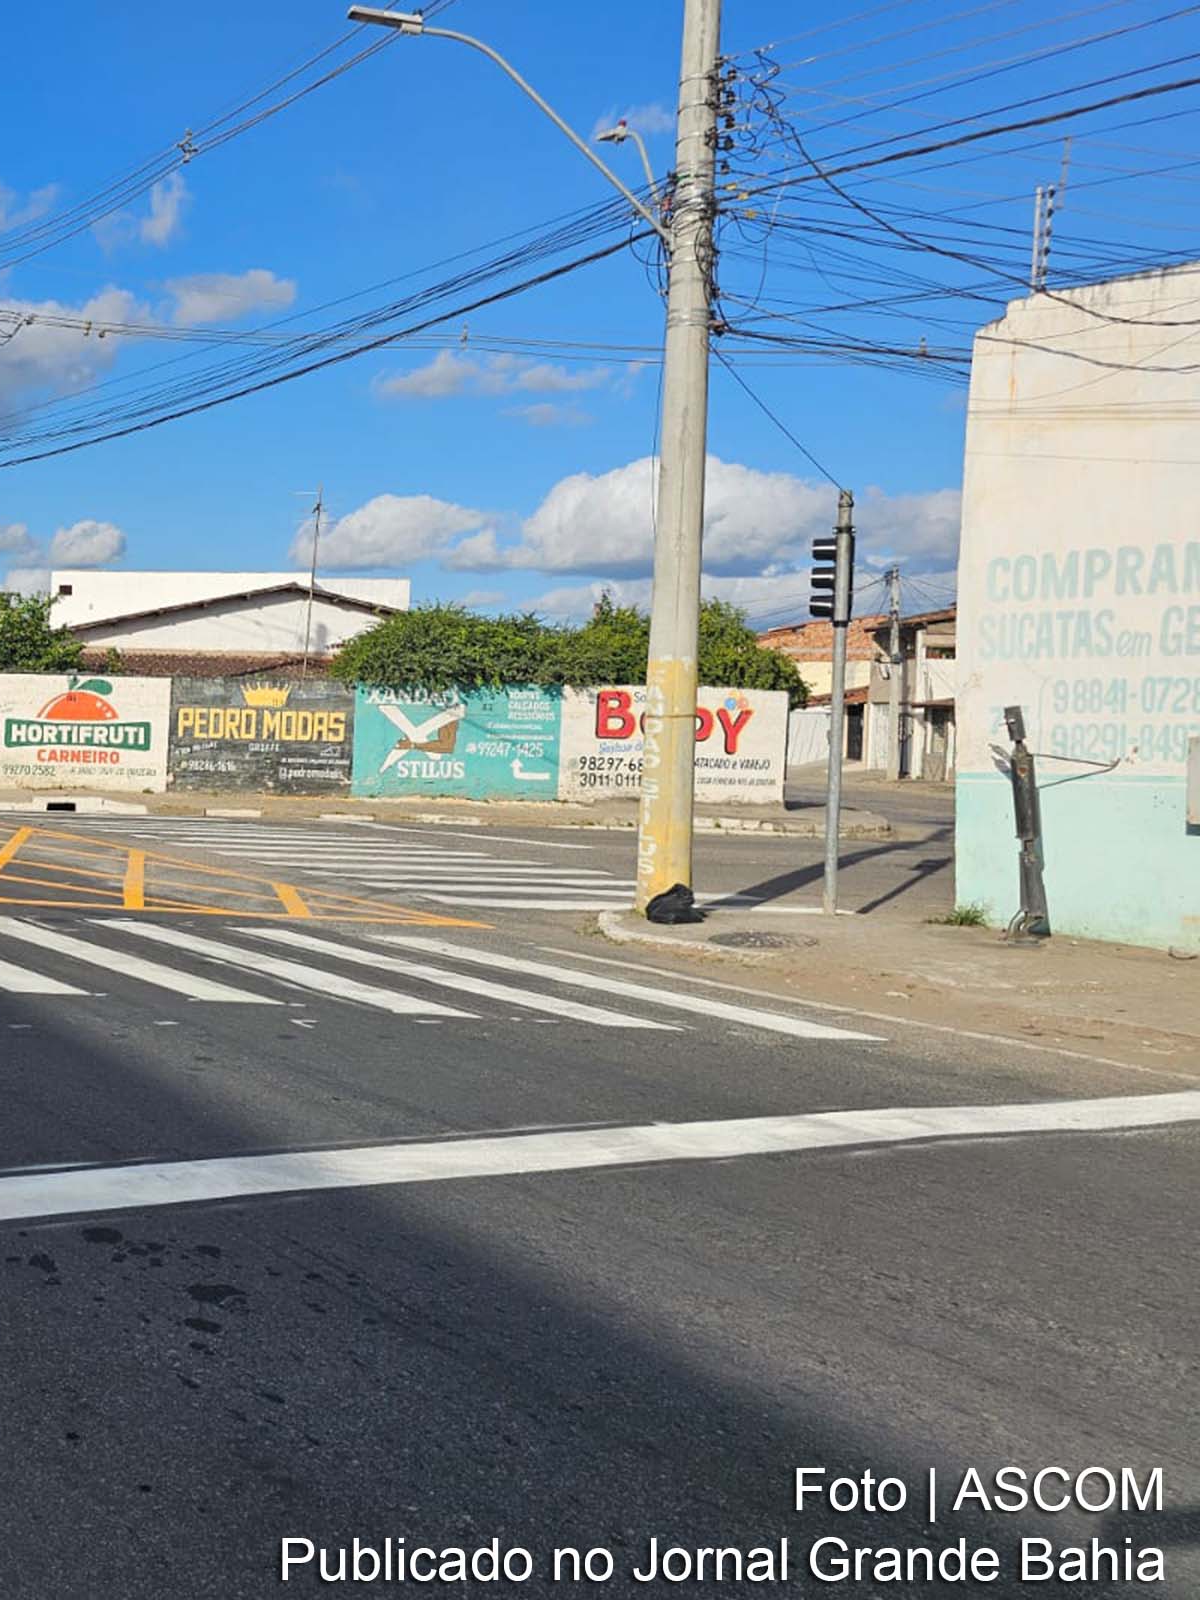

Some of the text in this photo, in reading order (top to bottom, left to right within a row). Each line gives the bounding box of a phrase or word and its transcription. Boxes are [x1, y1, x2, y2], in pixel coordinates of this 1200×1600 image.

[978, 611, 1115, 660] SUCATAS
[1116, 629, 1151, 657] em
[11, 724, 145, 745] HORTIFRUTI
[178, 707, 347, 742] PEDRO MODAS
[37, 748, 119, 764] CARNEIRO
[397, 761, 465, 779] STILUS
